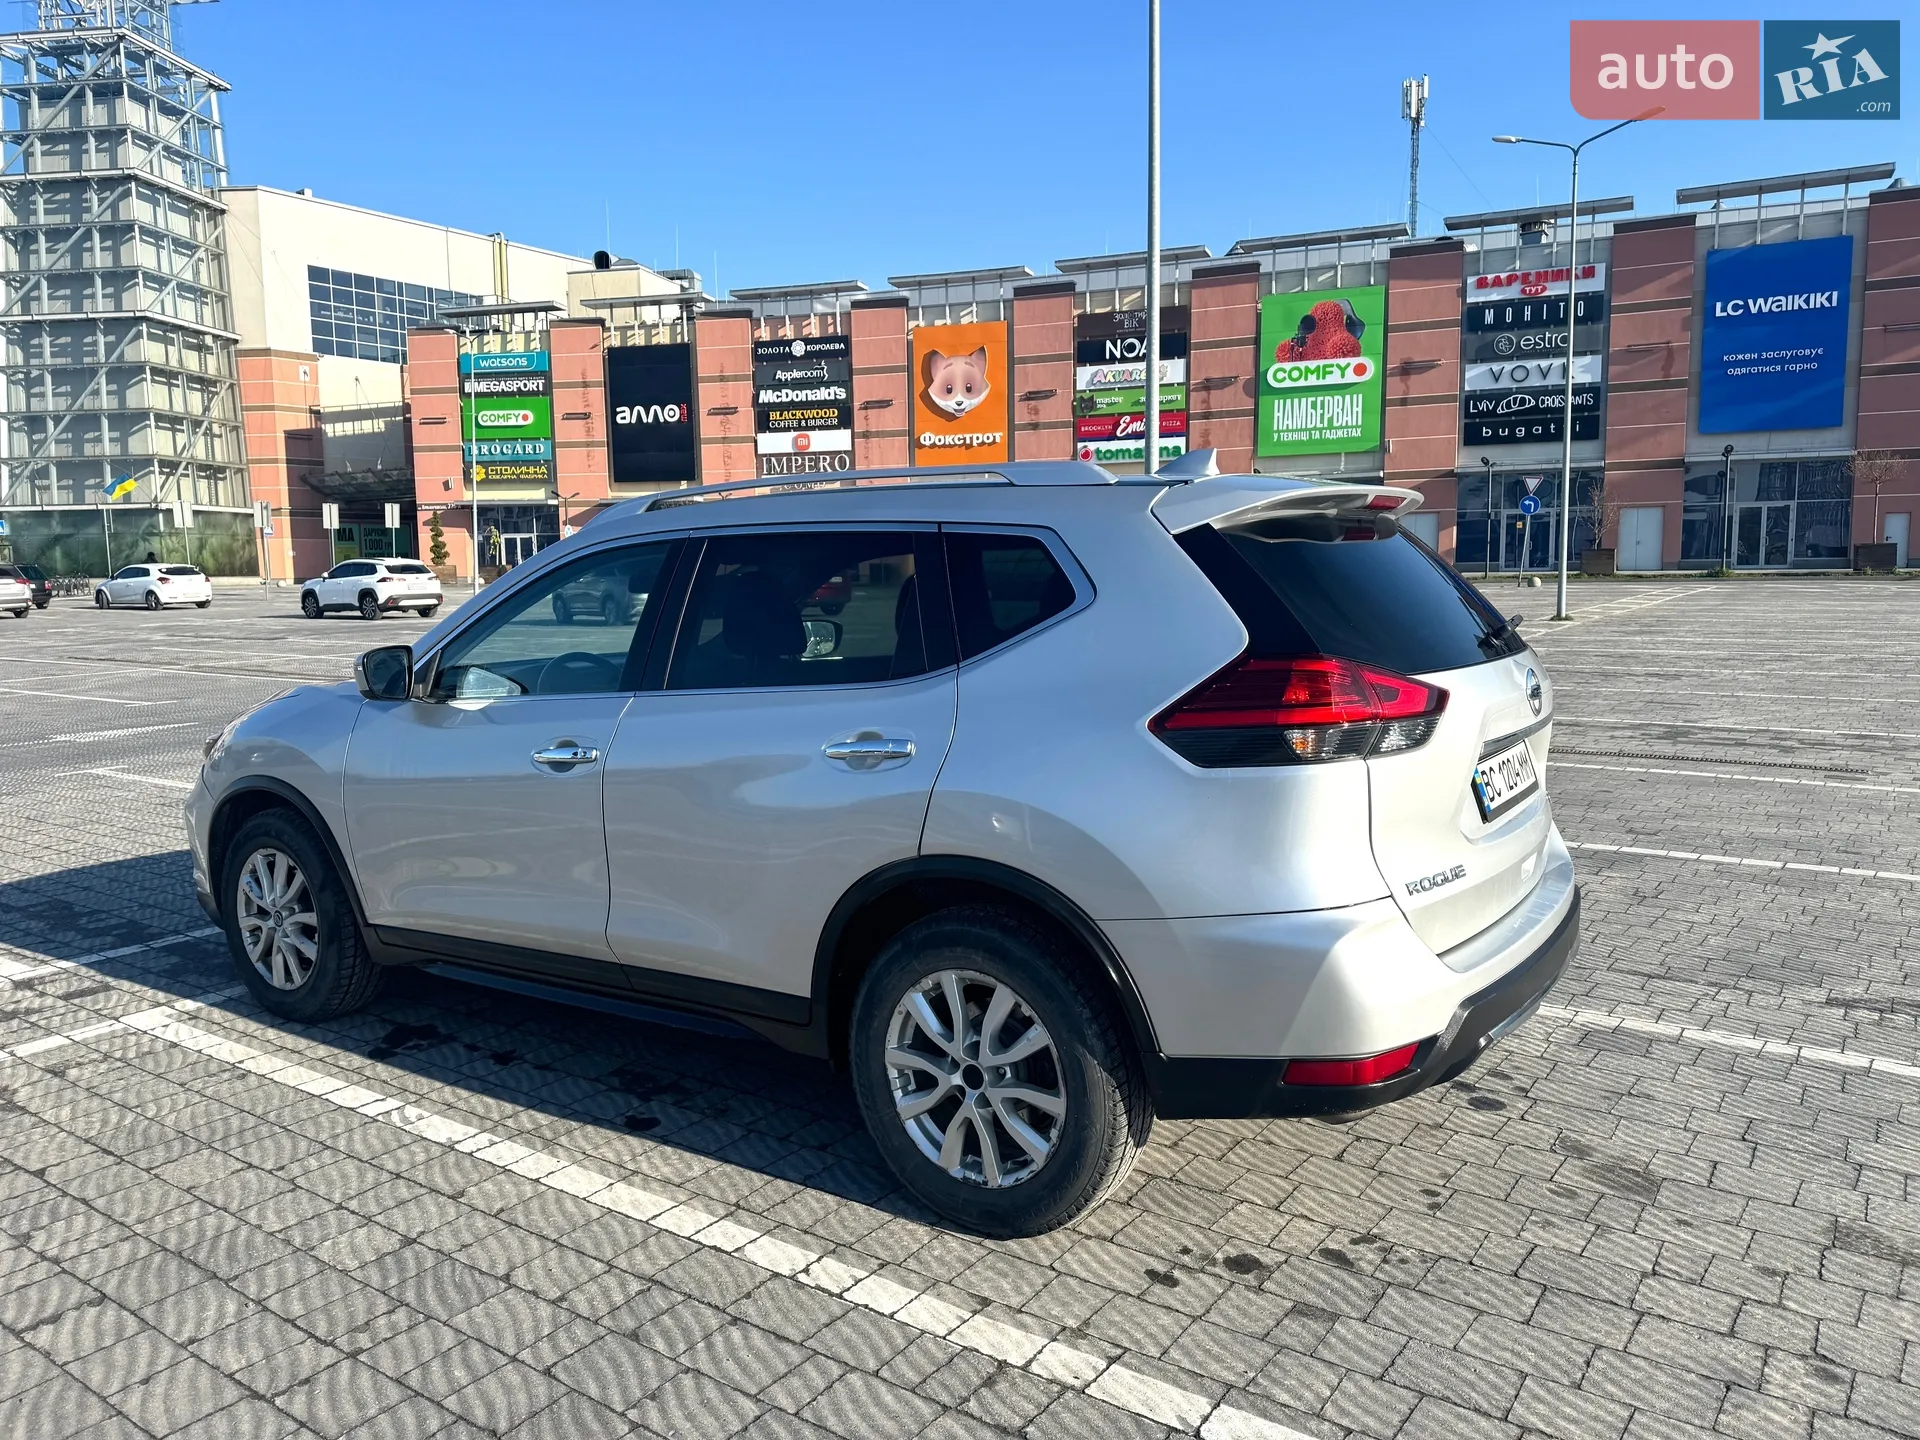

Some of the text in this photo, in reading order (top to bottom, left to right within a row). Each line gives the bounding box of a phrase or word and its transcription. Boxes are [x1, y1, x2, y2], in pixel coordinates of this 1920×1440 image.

[1475, 265, 1596, 289] ВАРЕНИКИ
[1524, 285, 1543, 294] ТУТ
[1484, 300, 1584, 325] MOHITO
[1715, 300, 1744, 317] LC
[756, 342, 845, 355] ЗОЛОТА КОРОЛЕВА
[1723, 347, 1824, 361] кожен заслуговує
[479, 357, 527, 367] watsons
[1727, 362, 1818, 376] одягатися гарно
[1272, 362, 1351, 383] COMFY
[474, 380, 545, 393] MEGASPORT
[758, 386, 847, 403] McDonald's
[480, 413, 520, 423] COMFY
[769, 408, 838, 420] BLACKWOOD
[1273, 393, 1363, 430] НАМБЕРВАН
[769, 418, 838, 428] COFFEE & BURGER
[1482, 421, 1580, 438] bugati
[919, 431, 1003, 447] Фокстрот
[1273, 428, 1362, 442] У ТЕХНІЦІ ТА ГАДЖЕТАХ
[470, 443, 545, 455] BROGARD
[1095, 445, 1182, 461] tomana
[488, 465, 548, 474] СТОЛИЧНА
[762, 453, 850, 474] IMPERO
[1480, 766, 1502, 803] BC
[1404, 864, 1467, 897] ROGUE
